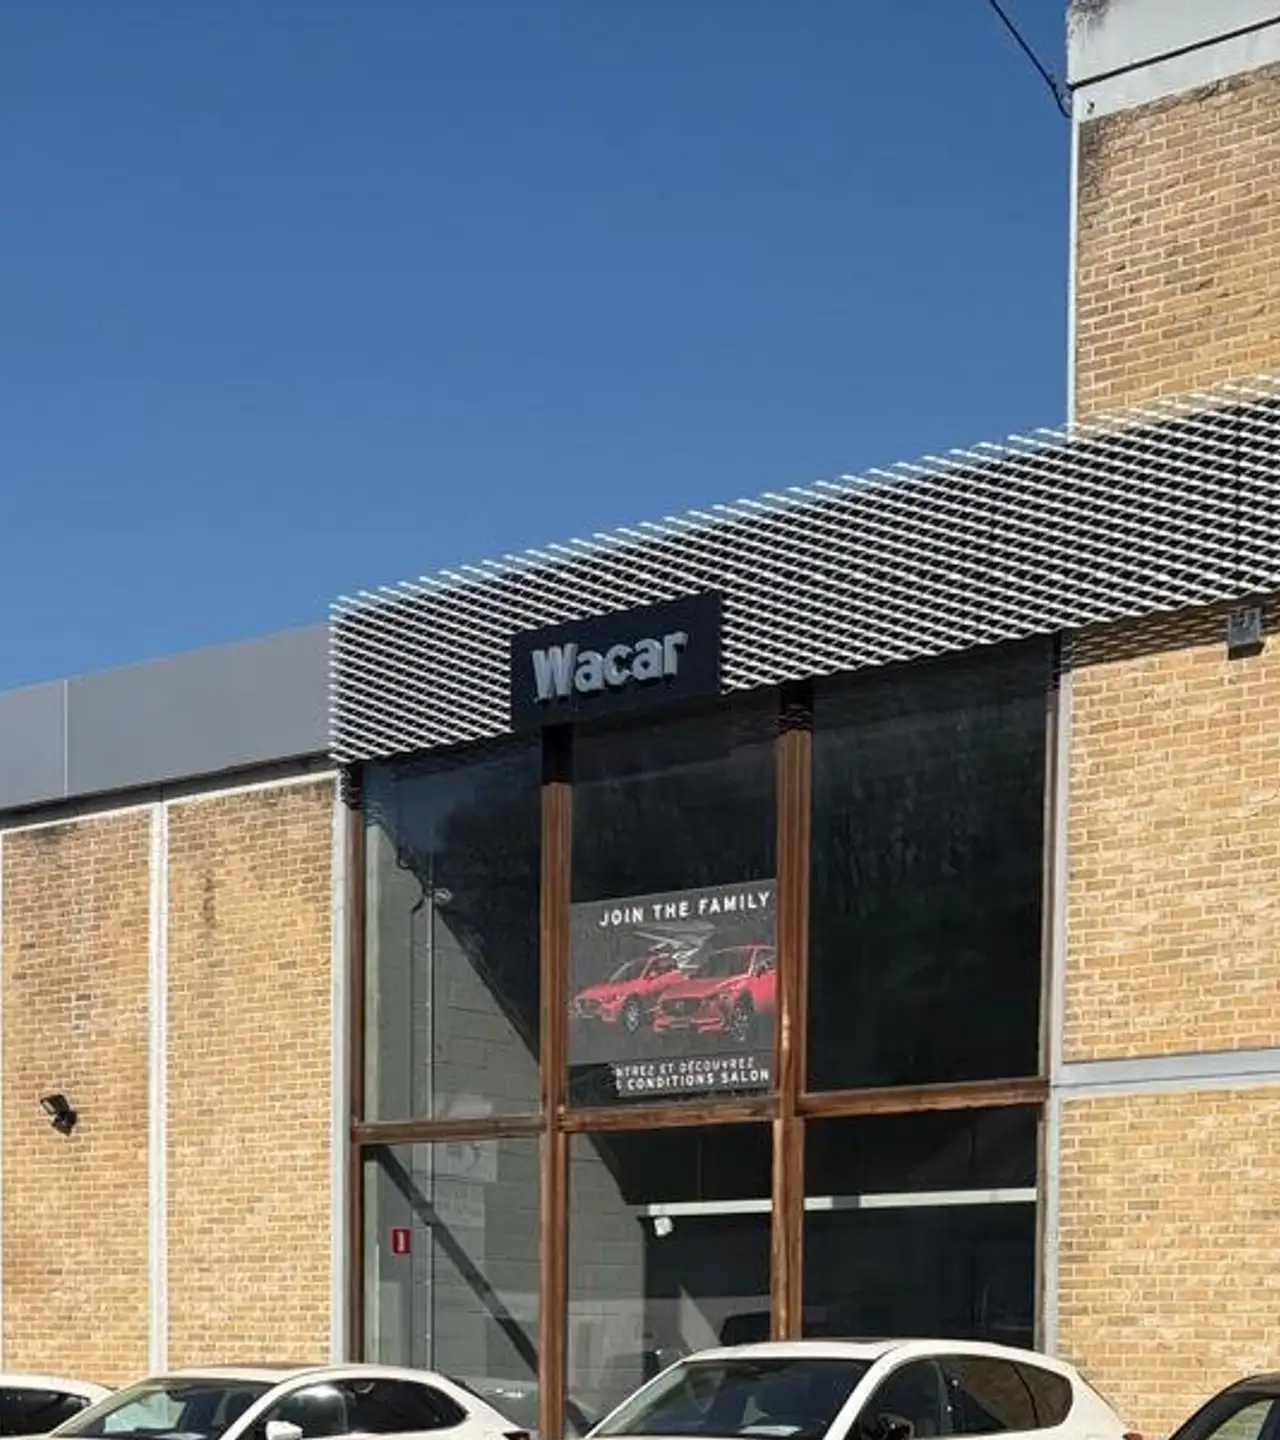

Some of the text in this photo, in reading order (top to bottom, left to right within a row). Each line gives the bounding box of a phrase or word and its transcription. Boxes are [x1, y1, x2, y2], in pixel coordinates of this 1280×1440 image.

[532, 631, 689, 700] Wacar
[599, 891, 770, 927] JOIN THE FAMILY
[627, 1072, 715, 1091] CONDITIONS
[721, 1068, 769, 1084] SALON
